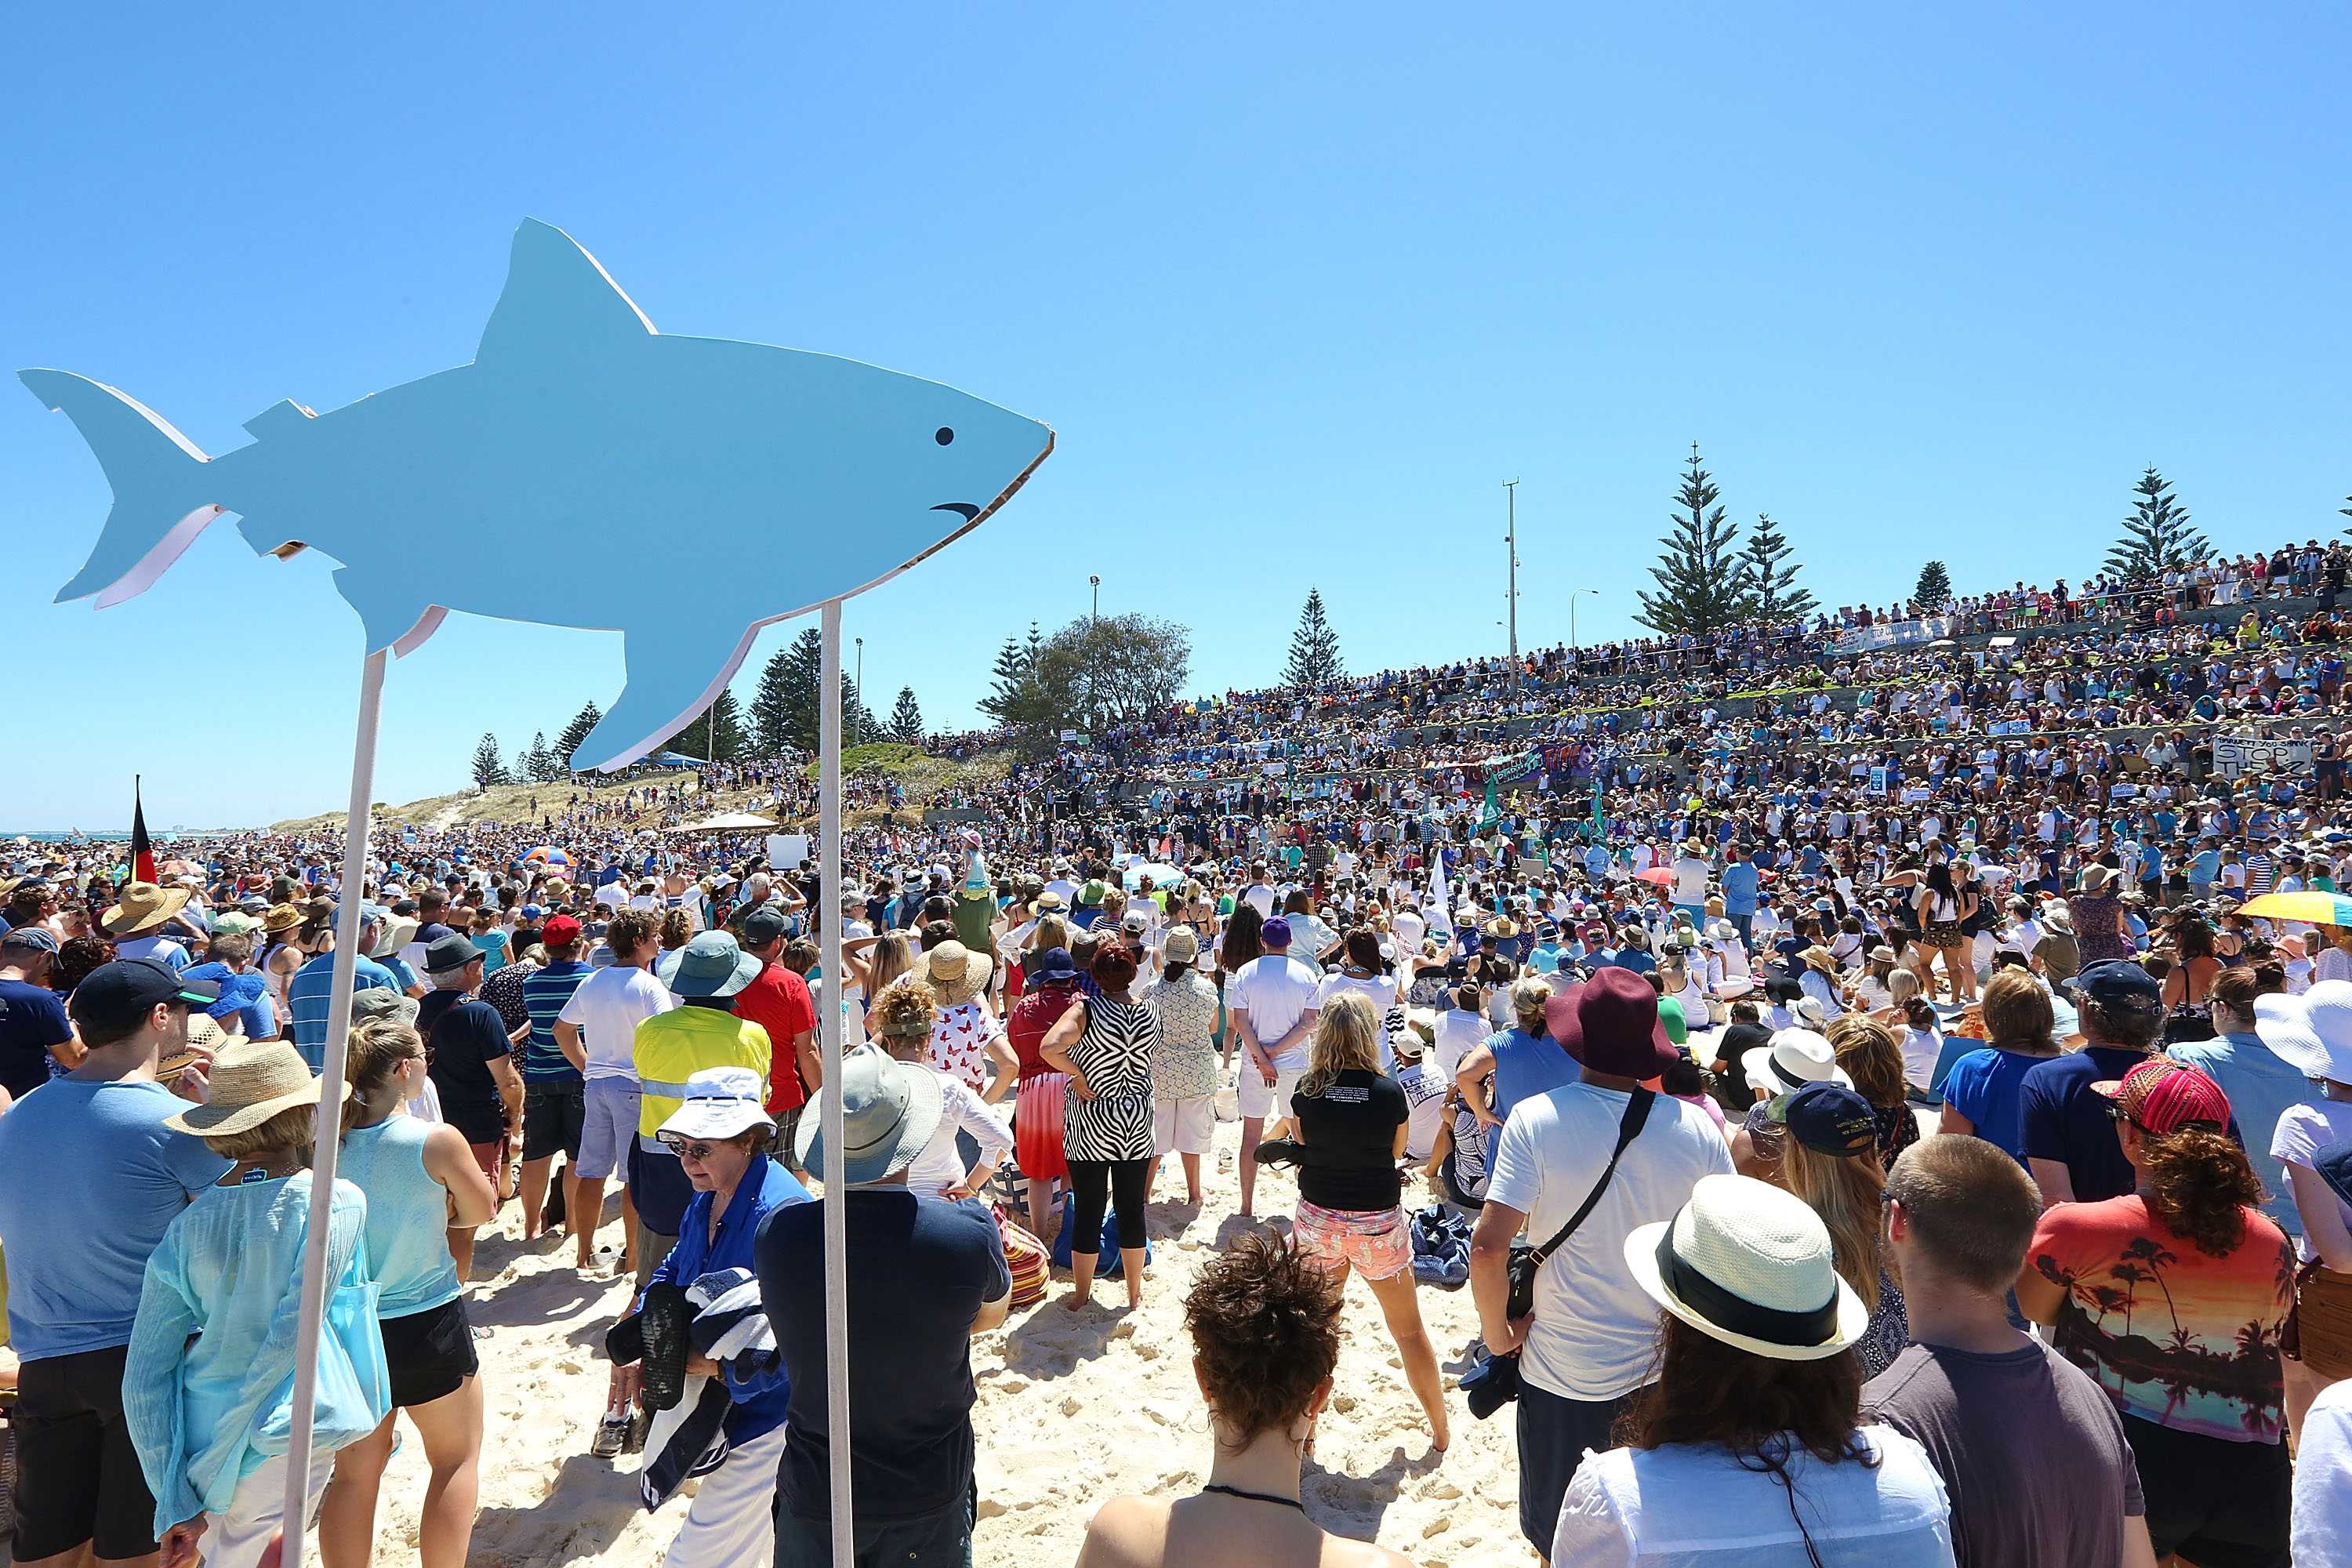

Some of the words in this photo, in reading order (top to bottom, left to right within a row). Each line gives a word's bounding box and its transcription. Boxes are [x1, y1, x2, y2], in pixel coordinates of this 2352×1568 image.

[1871, 628, 1884, 638] STOP
[2217, 760, 2265, 775] THE
[1409, 1084, 1448, 1107] Busine
